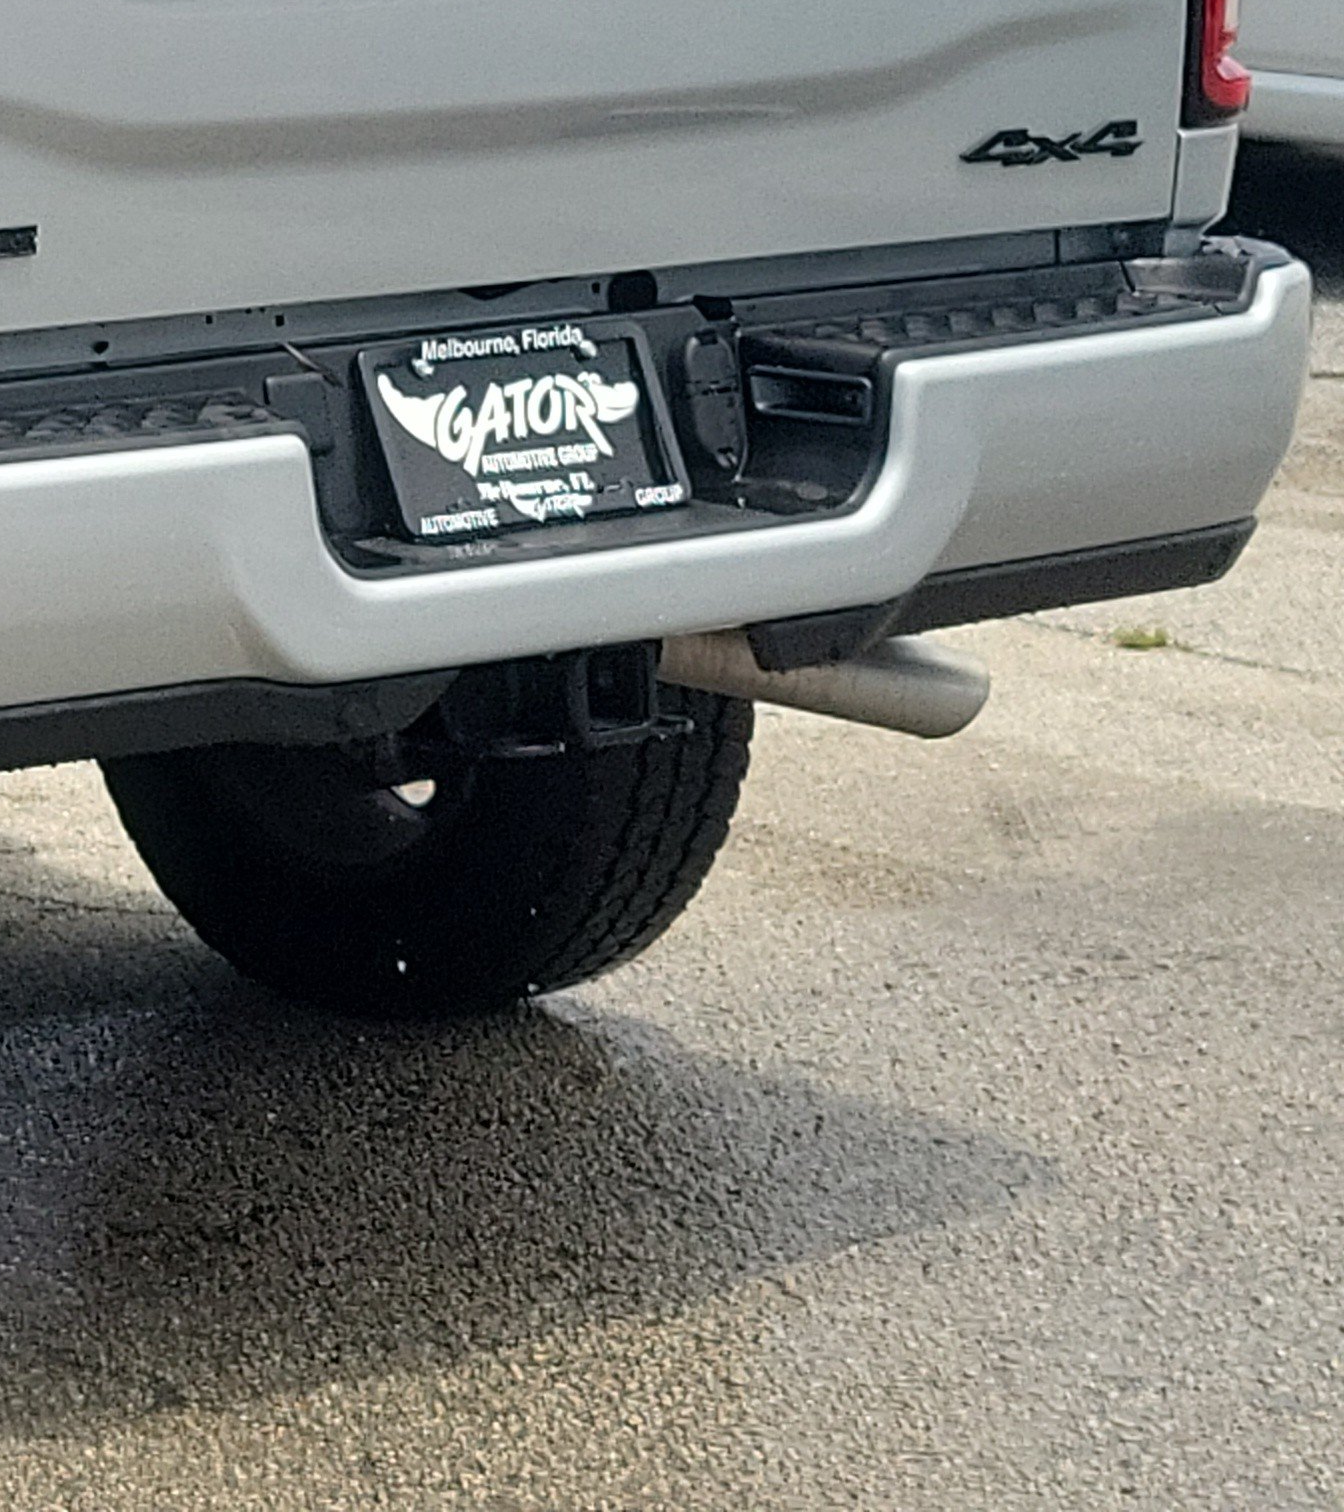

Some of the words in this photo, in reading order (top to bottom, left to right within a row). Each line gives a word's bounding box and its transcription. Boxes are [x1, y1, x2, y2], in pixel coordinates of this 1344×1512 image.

[959, 119, 1144, 167] 4x4
[421, 336, 520, 362] Melbourne,
[522, 324, 583, 351] Florida
[436, 373, 613, 476] GATOR
[482, 445, 559, 474] AUTOMOTIVE
[559, 442, 599, 466] GROUP
[421, 508, 500, 534] AUTOMOTIVE
[635, 483, 684, 507] GROUP
